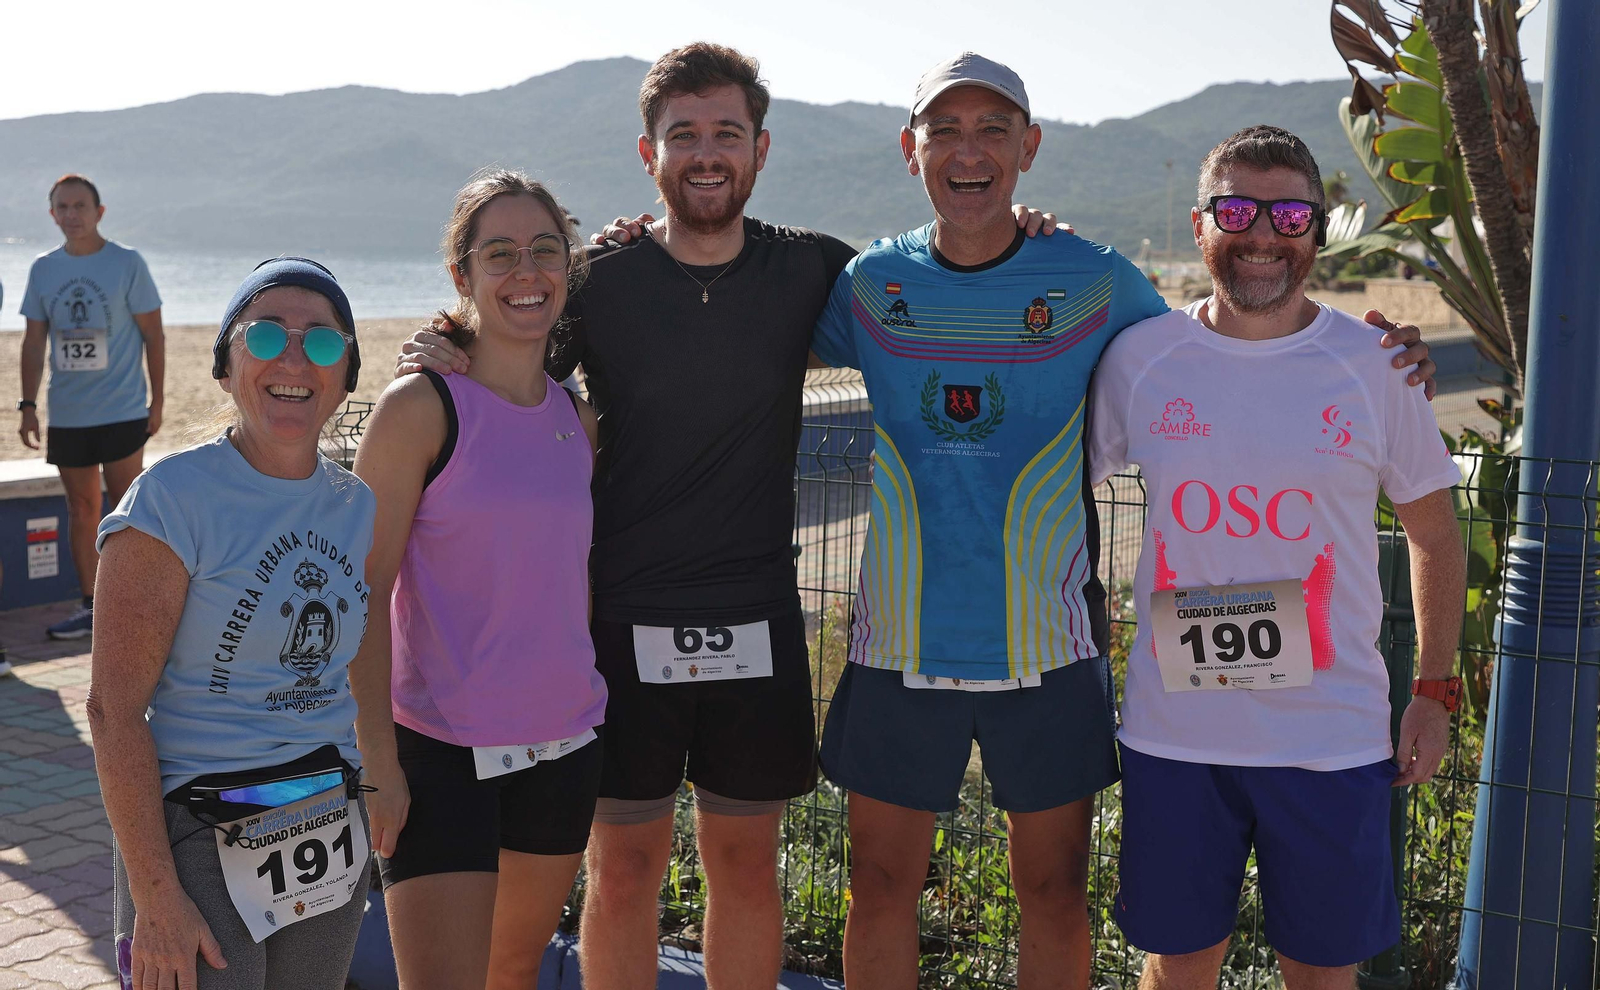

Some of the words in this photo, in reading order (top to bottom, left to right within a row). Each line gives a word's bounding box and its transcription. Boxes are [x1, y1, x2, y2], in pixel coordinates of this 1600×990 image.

[61, 343, 96, 359] 132
[1149, 421, 1212, 437] CAMBRE
[921, 448, 962, 456] VETERANOS
[962, 449, 1000, 458] ALGECIRAS
[955, 442, 985, 450] ATLETAS
[1171, 479, 1313, 541] OSC
[215, 588, 263, 662] CARRERA
[255, 531, 303, 584] URBANA
[307, 530, 353, 577] CIUDAD
[354, 580, 369, 604] DE
[1174, 591, 1188, 599] XXIV
[1174, 595, 1226, 609] CARRERA
[1225, 590, 1275, 605] URBANA
[1177, 607, 1212, 620] CIUDAD
[1213, 606, 1226, 617] DE
[1226, 601, 1277, 616] ALGECIRAS
[673, 627, 734, 654] 65
[1179, 619, 1282, 664] 190
[264, 687, 337, 705] Ayuntamiento
[245, 813, 304, 839] CARRERA
[246, 817, 261, 827] XXIV
[262, 808, 287, 823] EDICIÓN
[250, 832, 289, 851] CIUDAD
[289, 826, 304, 840] DE
[304, 806, 349, 833] ALGECIRA
[256, 823, 354, 896] 191
[272, 893, 294, 904] RIVERA
[325, 873, 349, 887] YOLANDA
